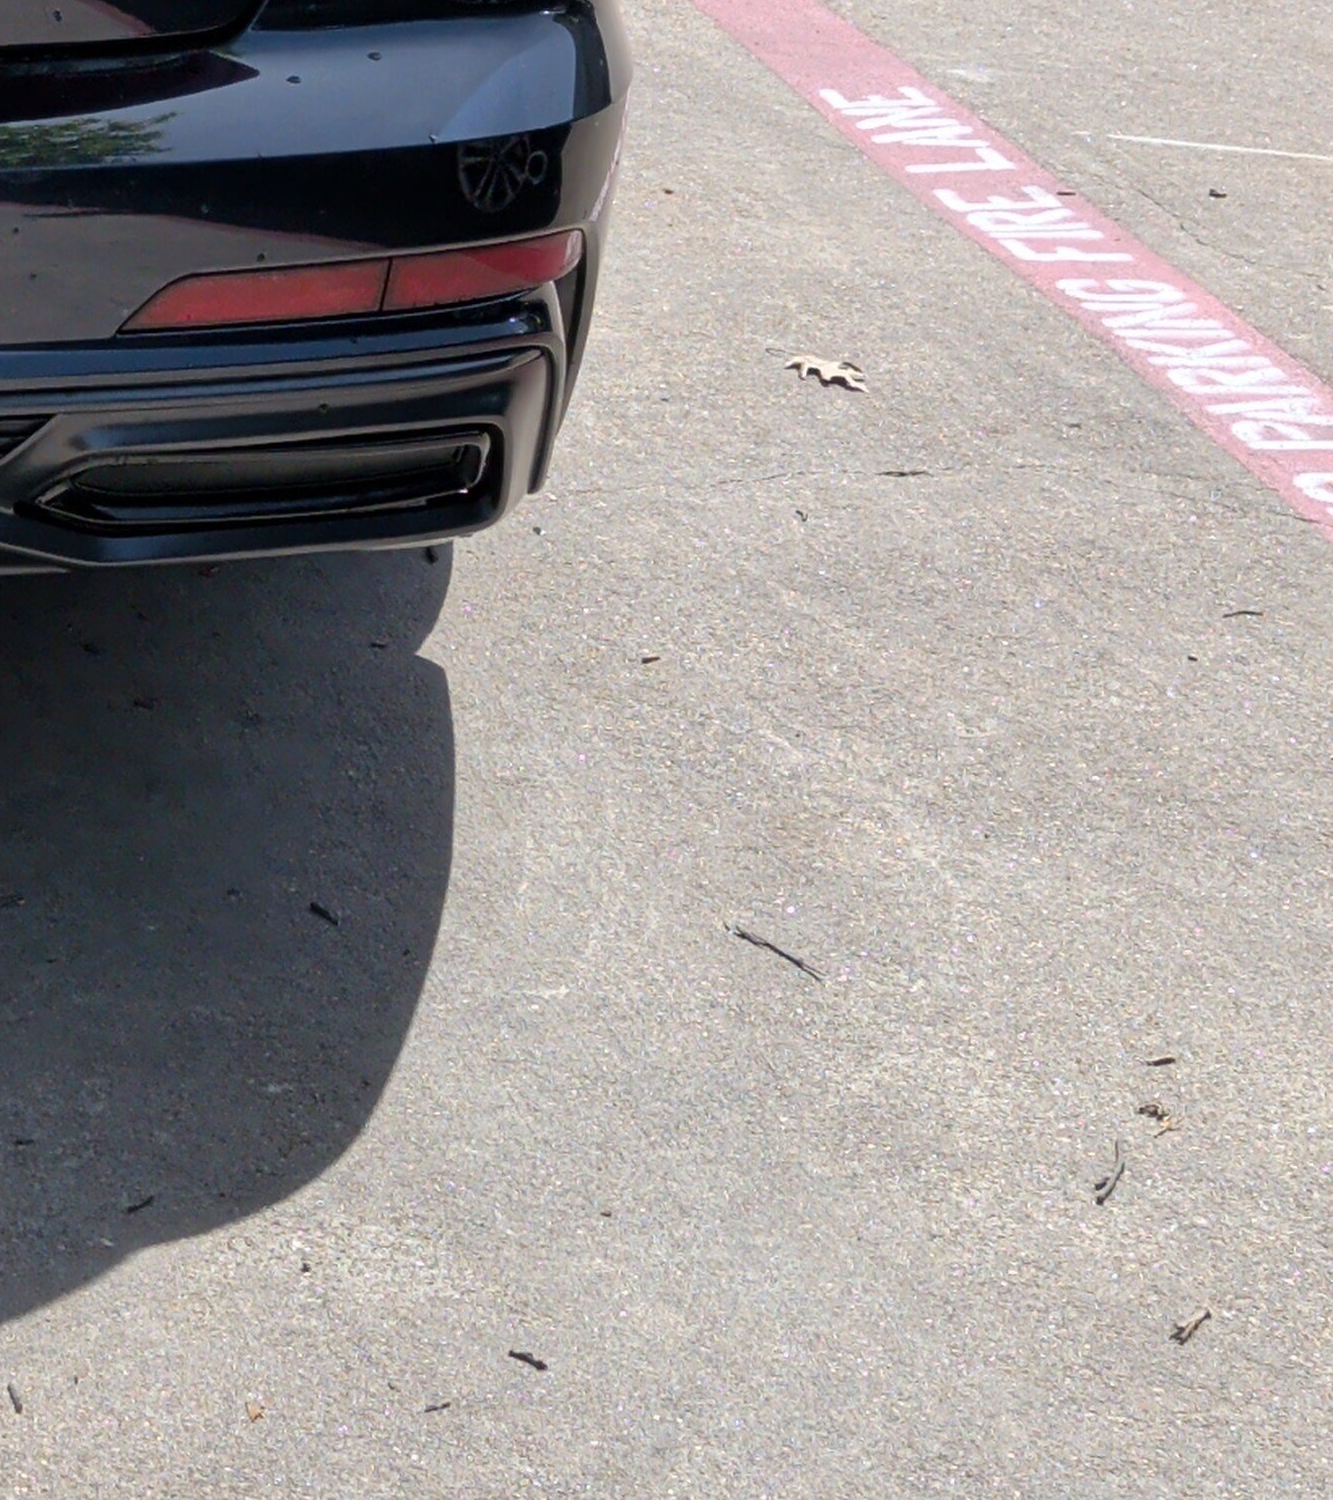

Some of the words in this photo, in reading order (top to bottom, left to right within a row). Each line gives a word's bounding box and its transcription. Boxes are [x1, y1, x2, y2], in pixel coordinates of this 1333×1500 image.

[819, 86, 1015, 174] LANE
[933, 185, 1133, 264] FIRE
[1055, 277, 1333, 450] PARKING
